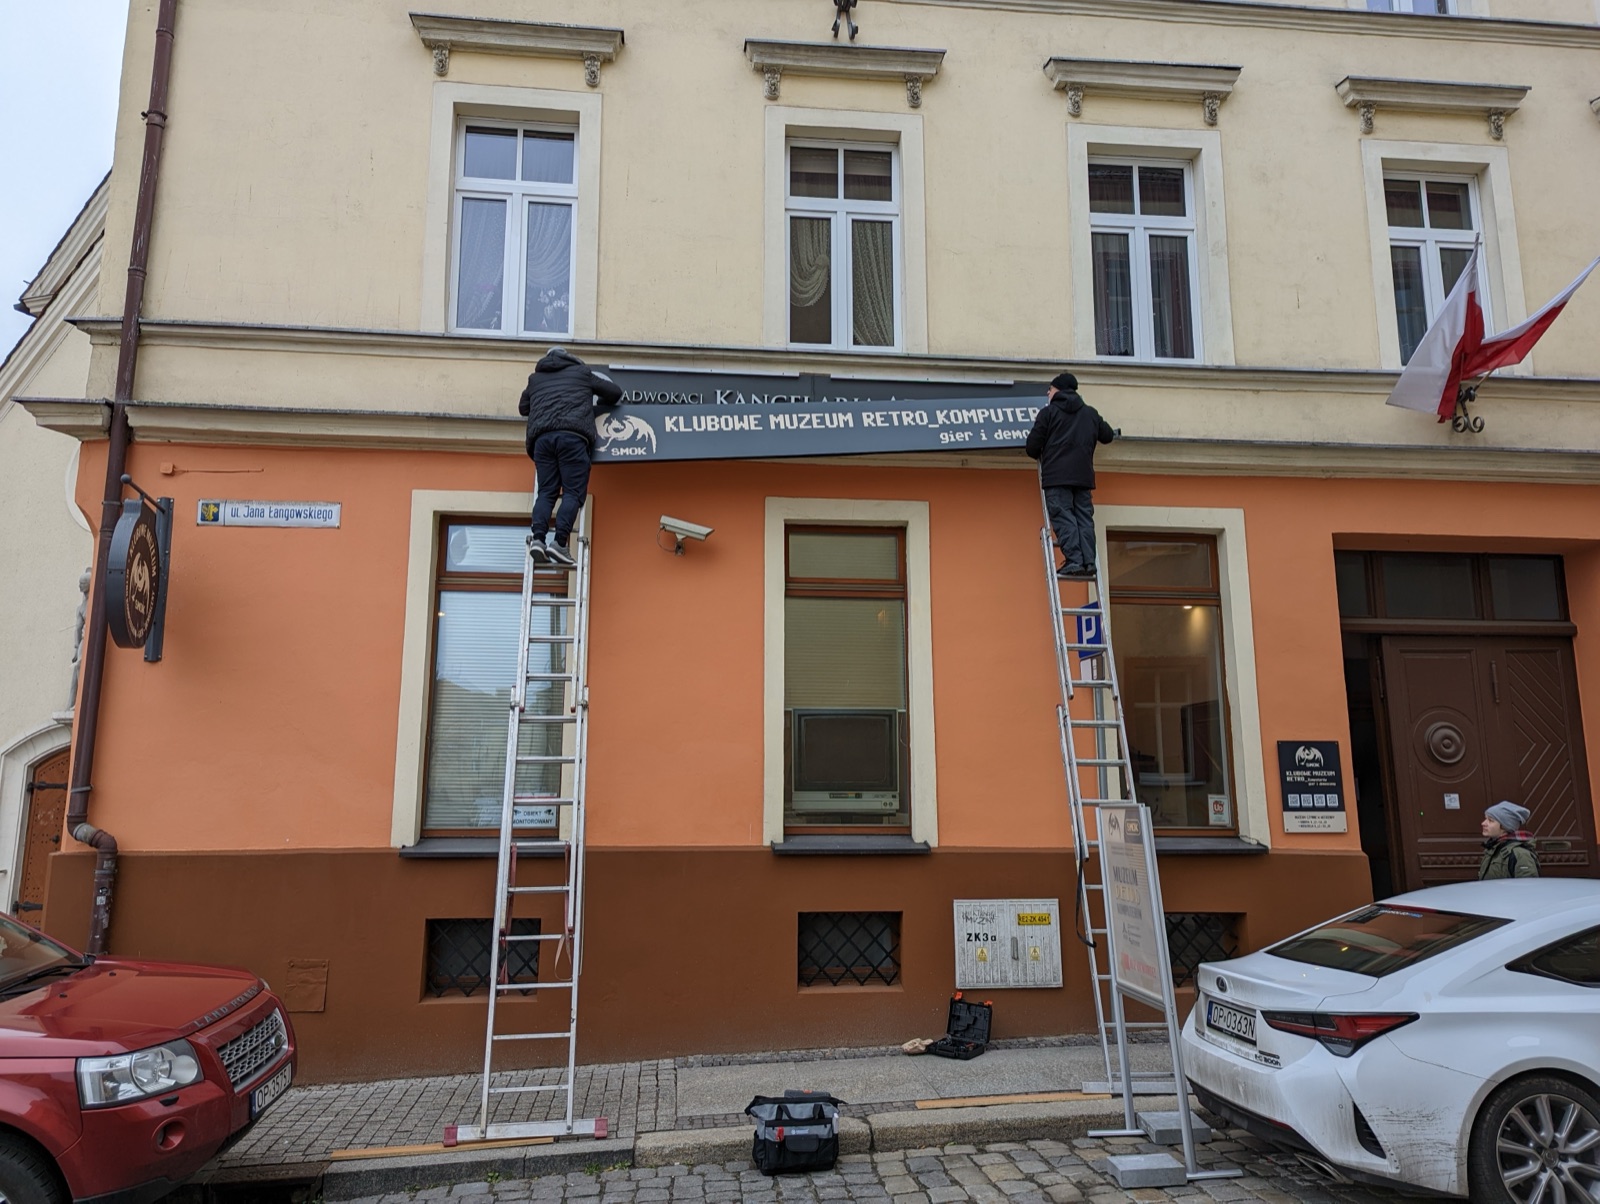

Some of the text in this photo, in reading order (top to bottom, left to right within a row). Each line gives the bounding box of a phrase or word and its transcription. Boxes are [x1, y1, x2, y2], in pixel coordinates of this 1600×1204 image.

[620, 389, 704, 405] ADWOKACI
[664, 403, 1049, 432] KLUBOWE MUZEUM RETRO_KOMPUTER
[940, 428, 1031, 444] gier i demo
[611, 447, 647, 456] SMOK
[242, 506, 265, 519] Jana
[268, 506, 334, 522] Łangowskiego
[1081, 615, 1097, 645] P
[1127, 822, 1139, 832] SMOK
[966, 932, 997, 942] ZK3a
[193, 984, 260, 1028] LAND ROVER
[1212, 1005, 1224, 1025] OP
[1226, 1011, 1256, 1038] 0363N
[257, 1084, 270, 1109] OP
